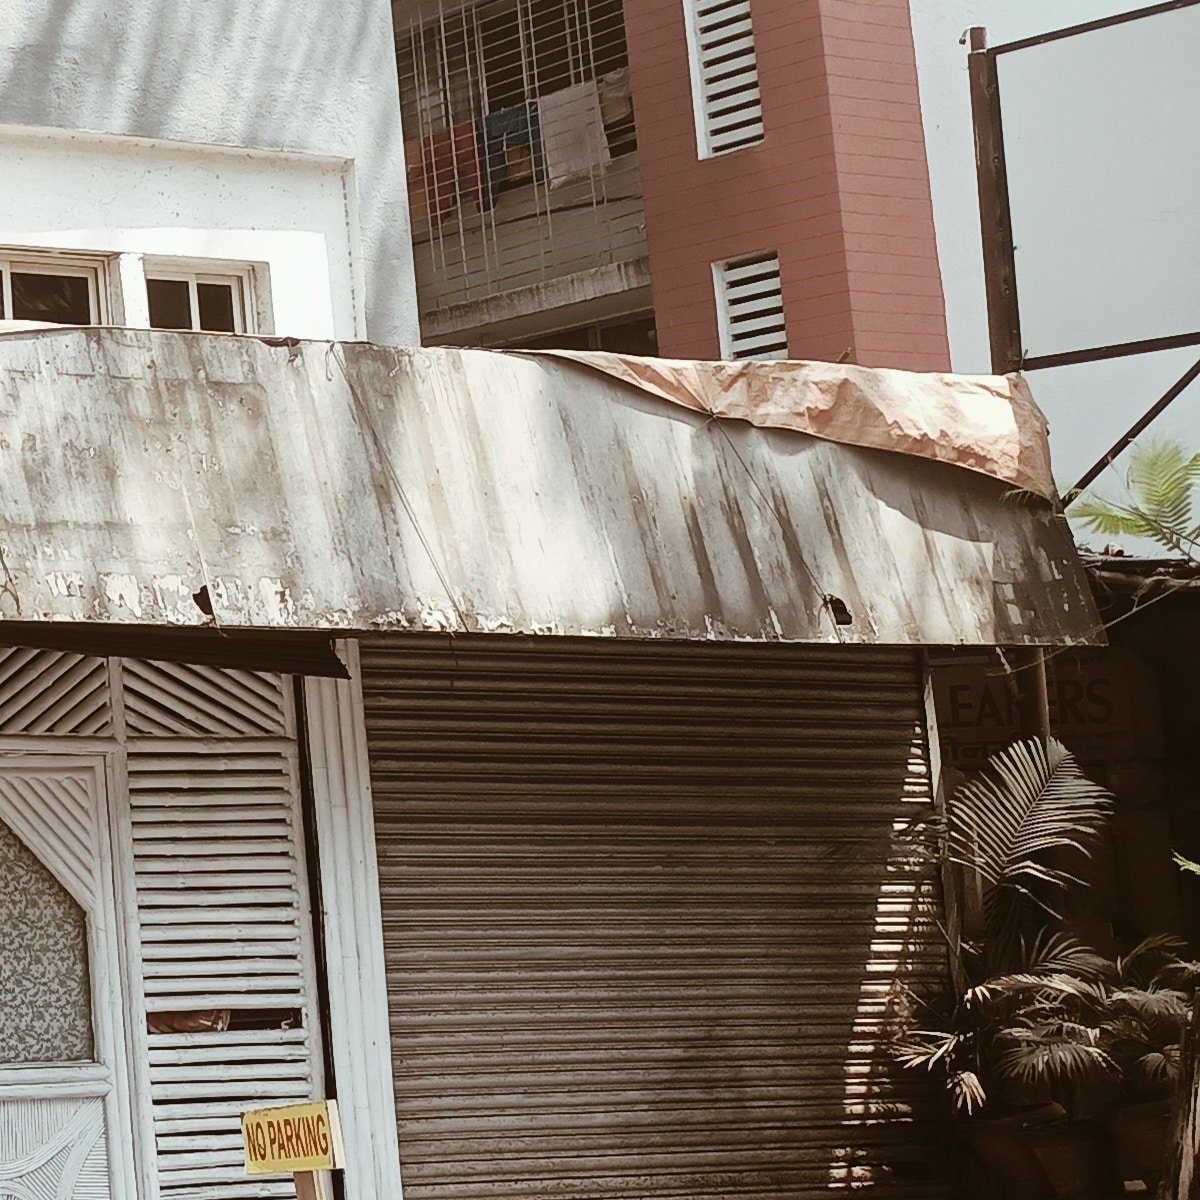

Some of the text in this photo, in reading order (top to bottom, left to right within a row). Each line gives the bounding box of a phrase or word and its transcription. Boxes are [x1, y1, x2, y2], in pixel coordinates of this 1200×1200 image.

[938, 678, 1115, 728] EAERS
[246, 1113, 329, 1161] NO PARKING
